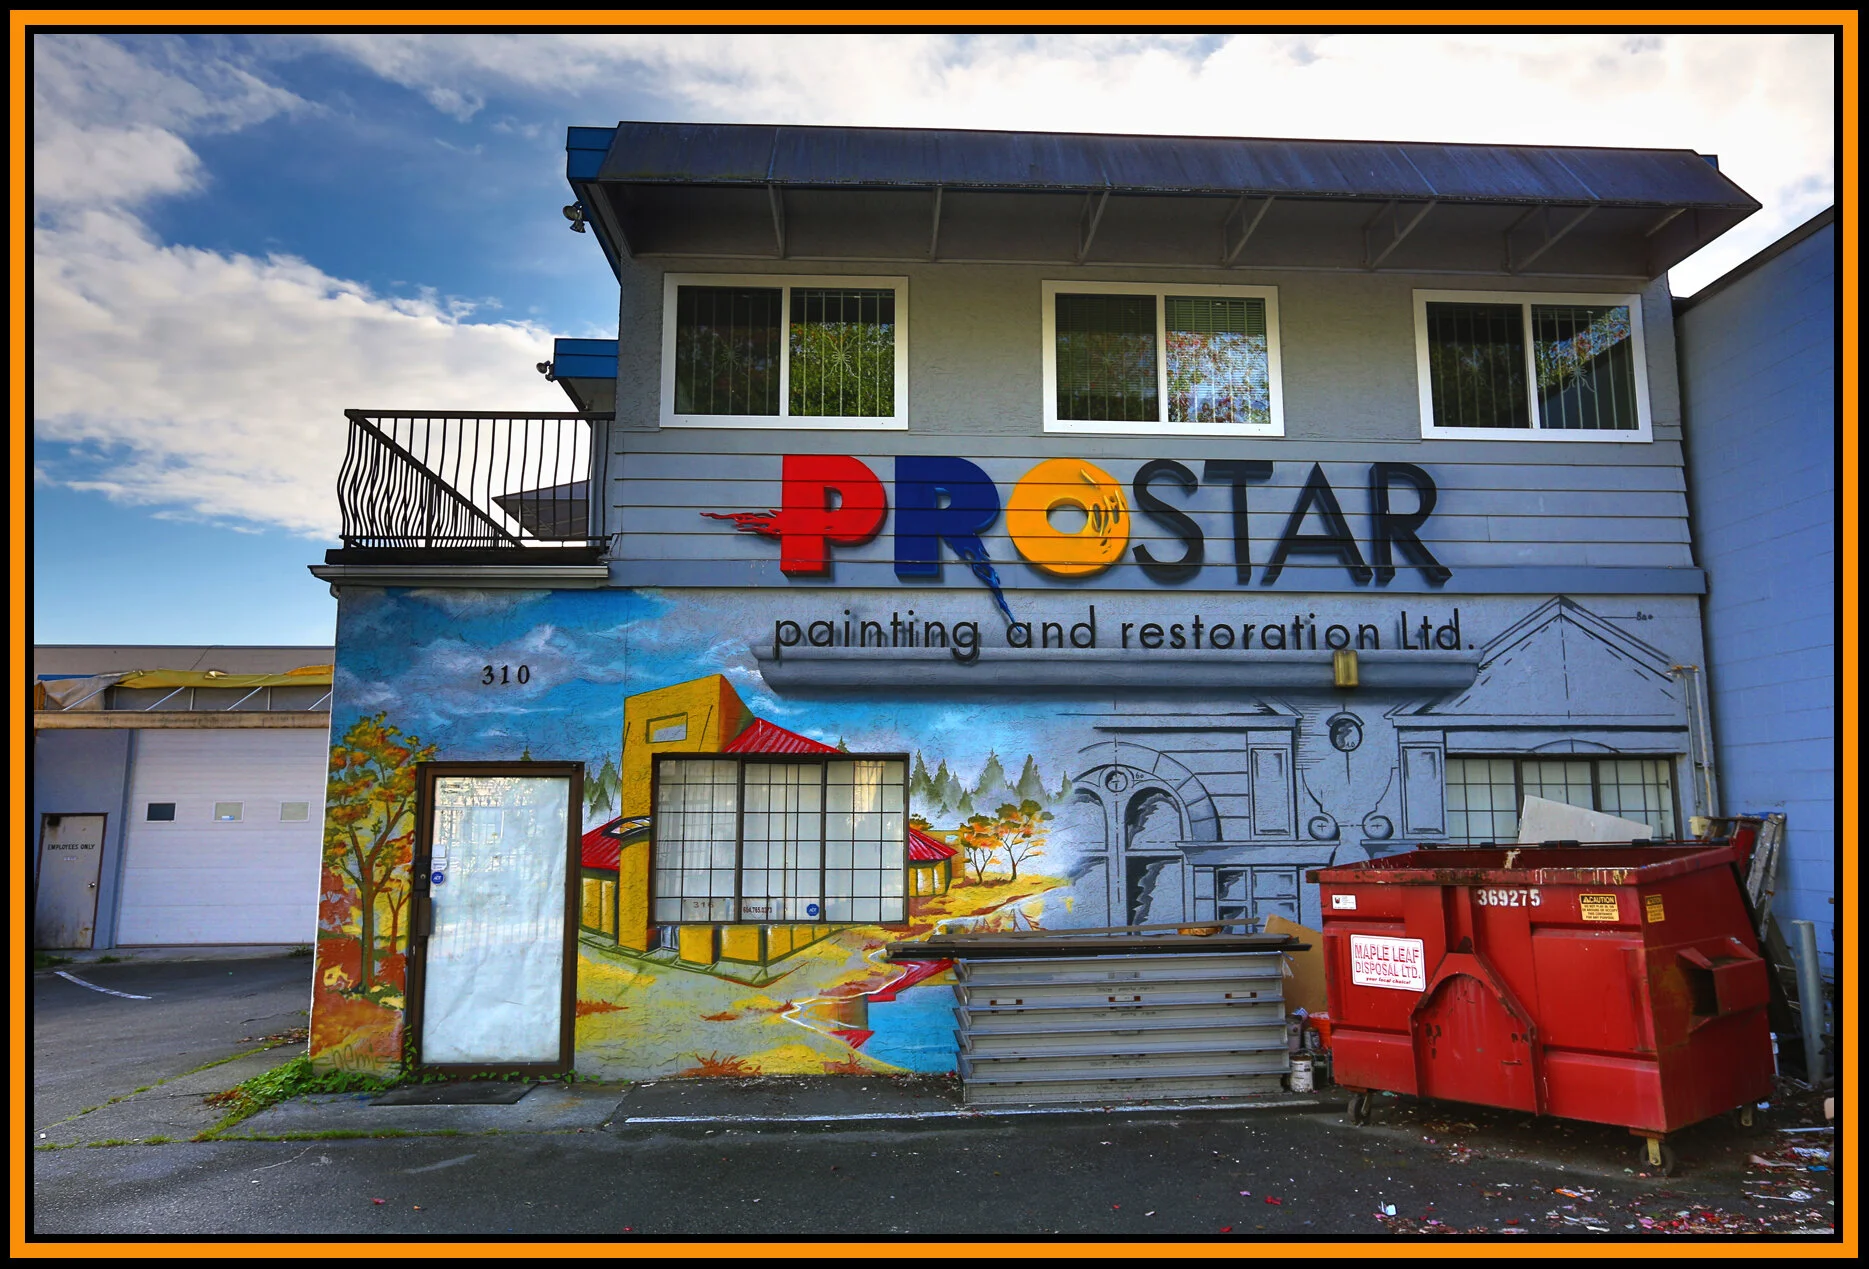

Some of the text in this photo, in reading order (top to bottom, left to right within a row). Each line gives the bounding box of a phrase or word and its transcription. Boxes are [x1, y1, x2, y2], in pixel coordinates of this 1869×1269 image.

[777, 453, 1454, 590] PROSTAR
[774, 604, 1476, 662] painting and restoration Ltd.
[482, 664, 531, 685] 310
[47, 843, 79, 851] EMPLOYEES
[1477, 888, 1541, 907] 369275
[1589, 896, 1615, 904] CAUTION
[1355, 943, 1419, 963] MAPLE LEAF
[1355, 961, 1421, 979] DISPOSAL LTD.
